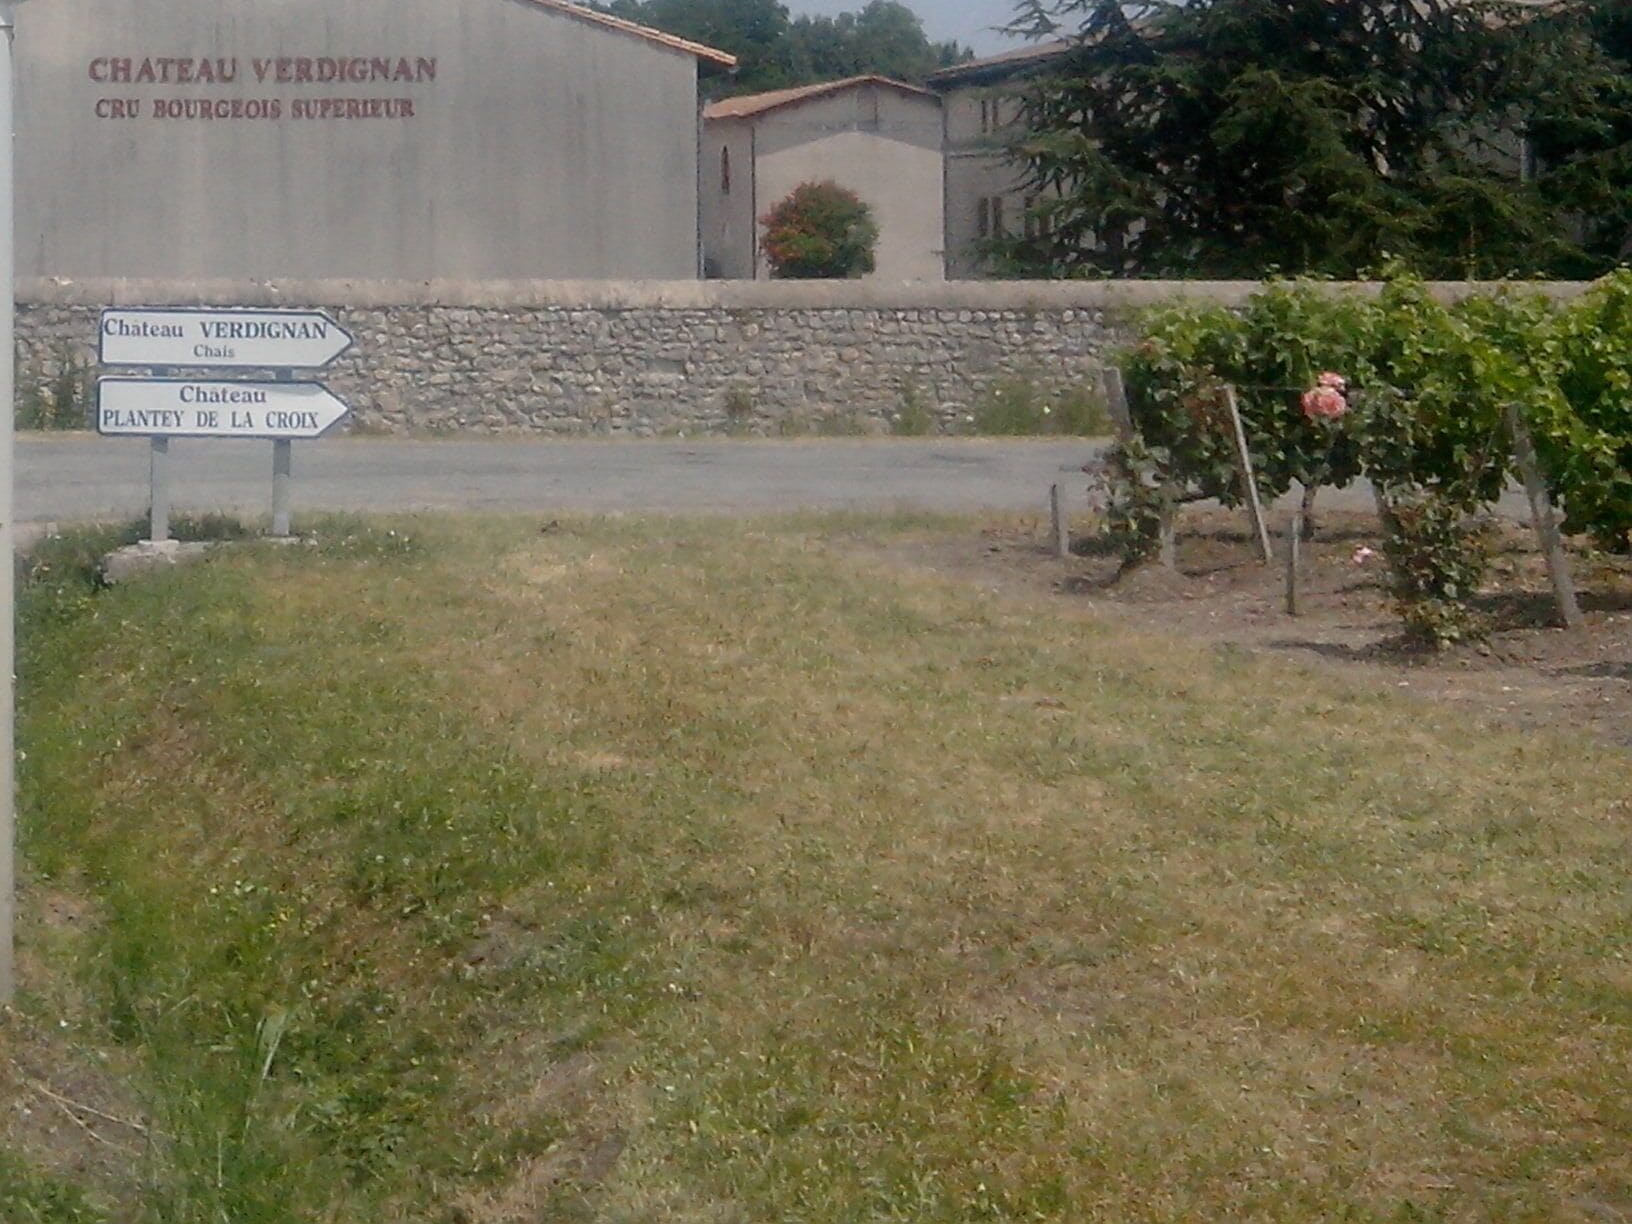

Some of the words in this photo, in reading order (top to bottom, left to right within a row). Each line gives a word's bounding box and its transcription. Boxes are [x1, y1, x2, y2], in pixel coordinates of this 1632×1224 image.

[89, 57, 237, 83] CHATEAU
[252, 56, 437, 83] VERDIGNAN
[95, 98, 140, 119] CRU
[153, 98, 281, 120] BOURGEOIS
[291, 98, 415, 120] SUPERIEUR
[200, 321, 328, 340] VERDIGNAN
[193, 344, 235, 358] Chais
[103, 409, 184, 428] PLANTEY
[196, 410, 218, 428] DE
[231, 411, 254, 428] LA
[265, 411, 319, 429] CROIX
